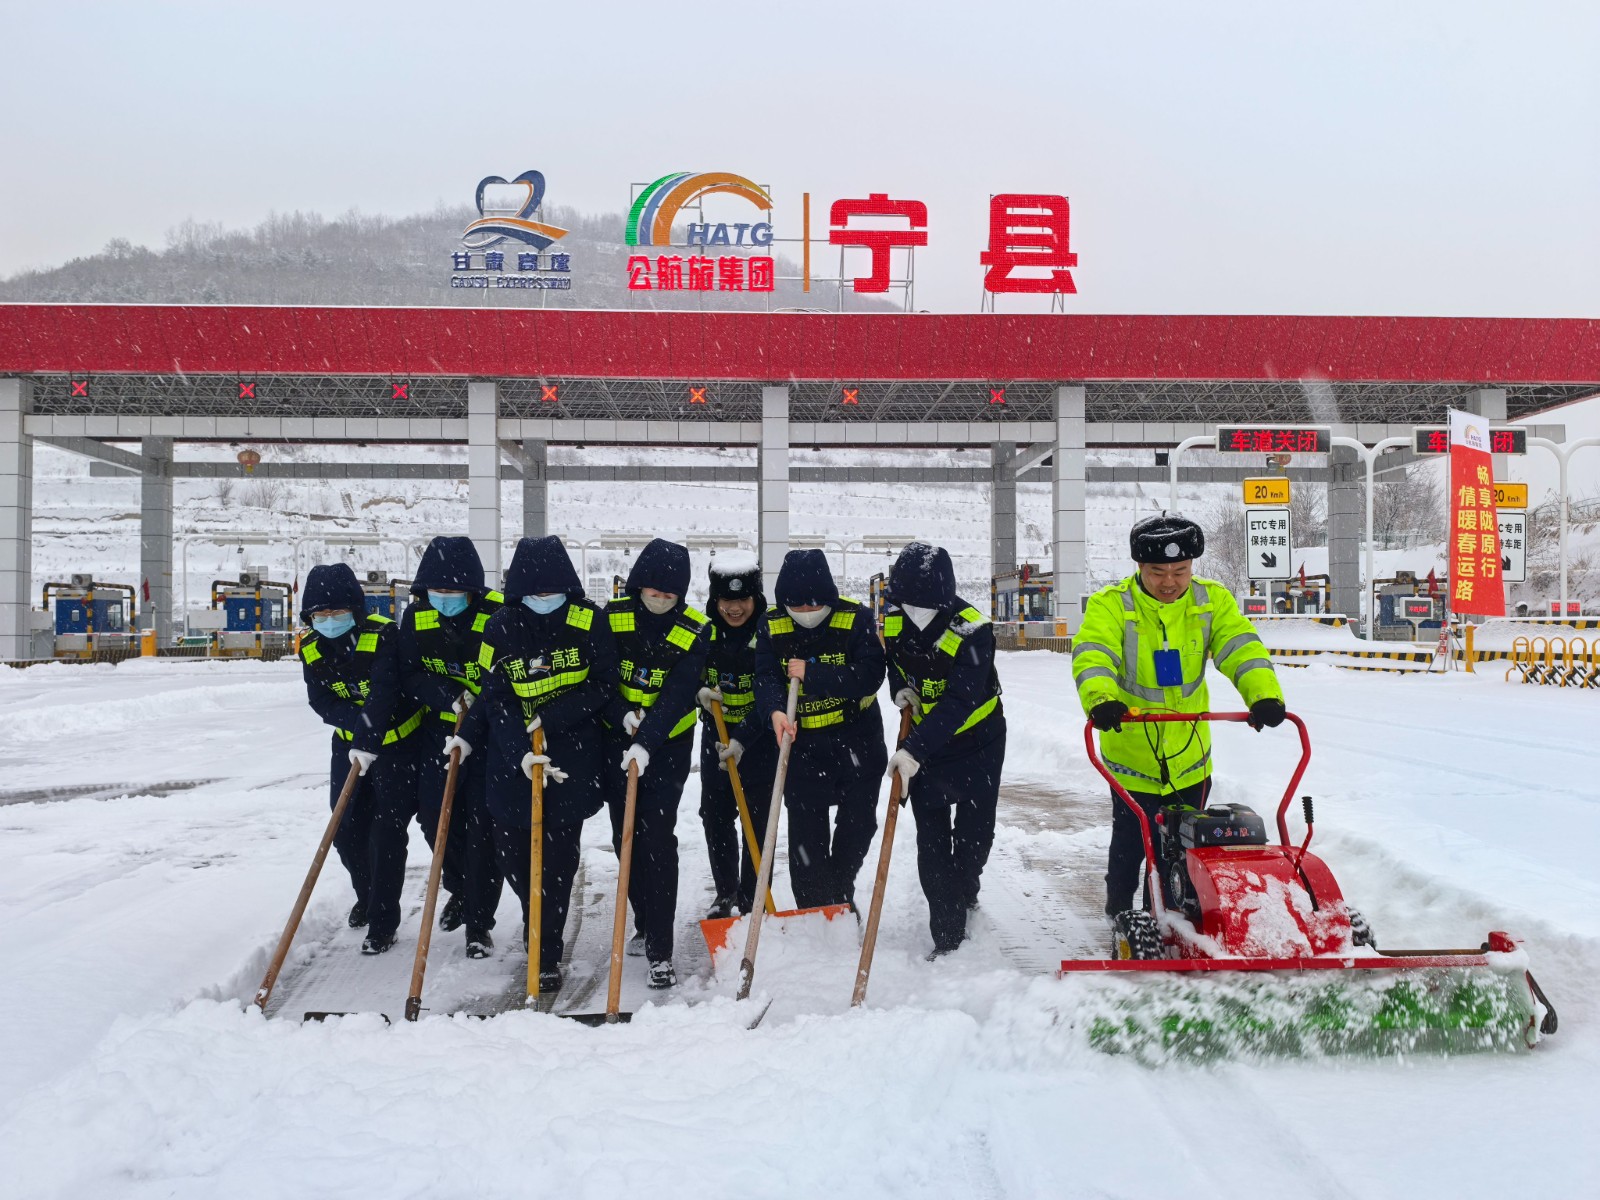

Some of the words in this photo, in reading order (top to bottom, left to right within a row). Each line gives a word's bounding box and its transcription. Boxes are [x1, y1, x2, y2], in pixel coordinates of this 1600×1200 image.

[687, 222, 774, 247] HATG
[829, 193, 1078, 294] 宁县
[626, 254, 775, 292] 公航旅集团
[1230, 429, 1318, 452] 车道关闭
[1255, 486, 1268, 499] 20
[1476, 465, 1497, 578] 畅享陇原行
[1251, 535, 1287, 546] 保持车距
[1455, 485, 1487, 602] 情暖春运路
[550, 646, 581, 671] 高速
